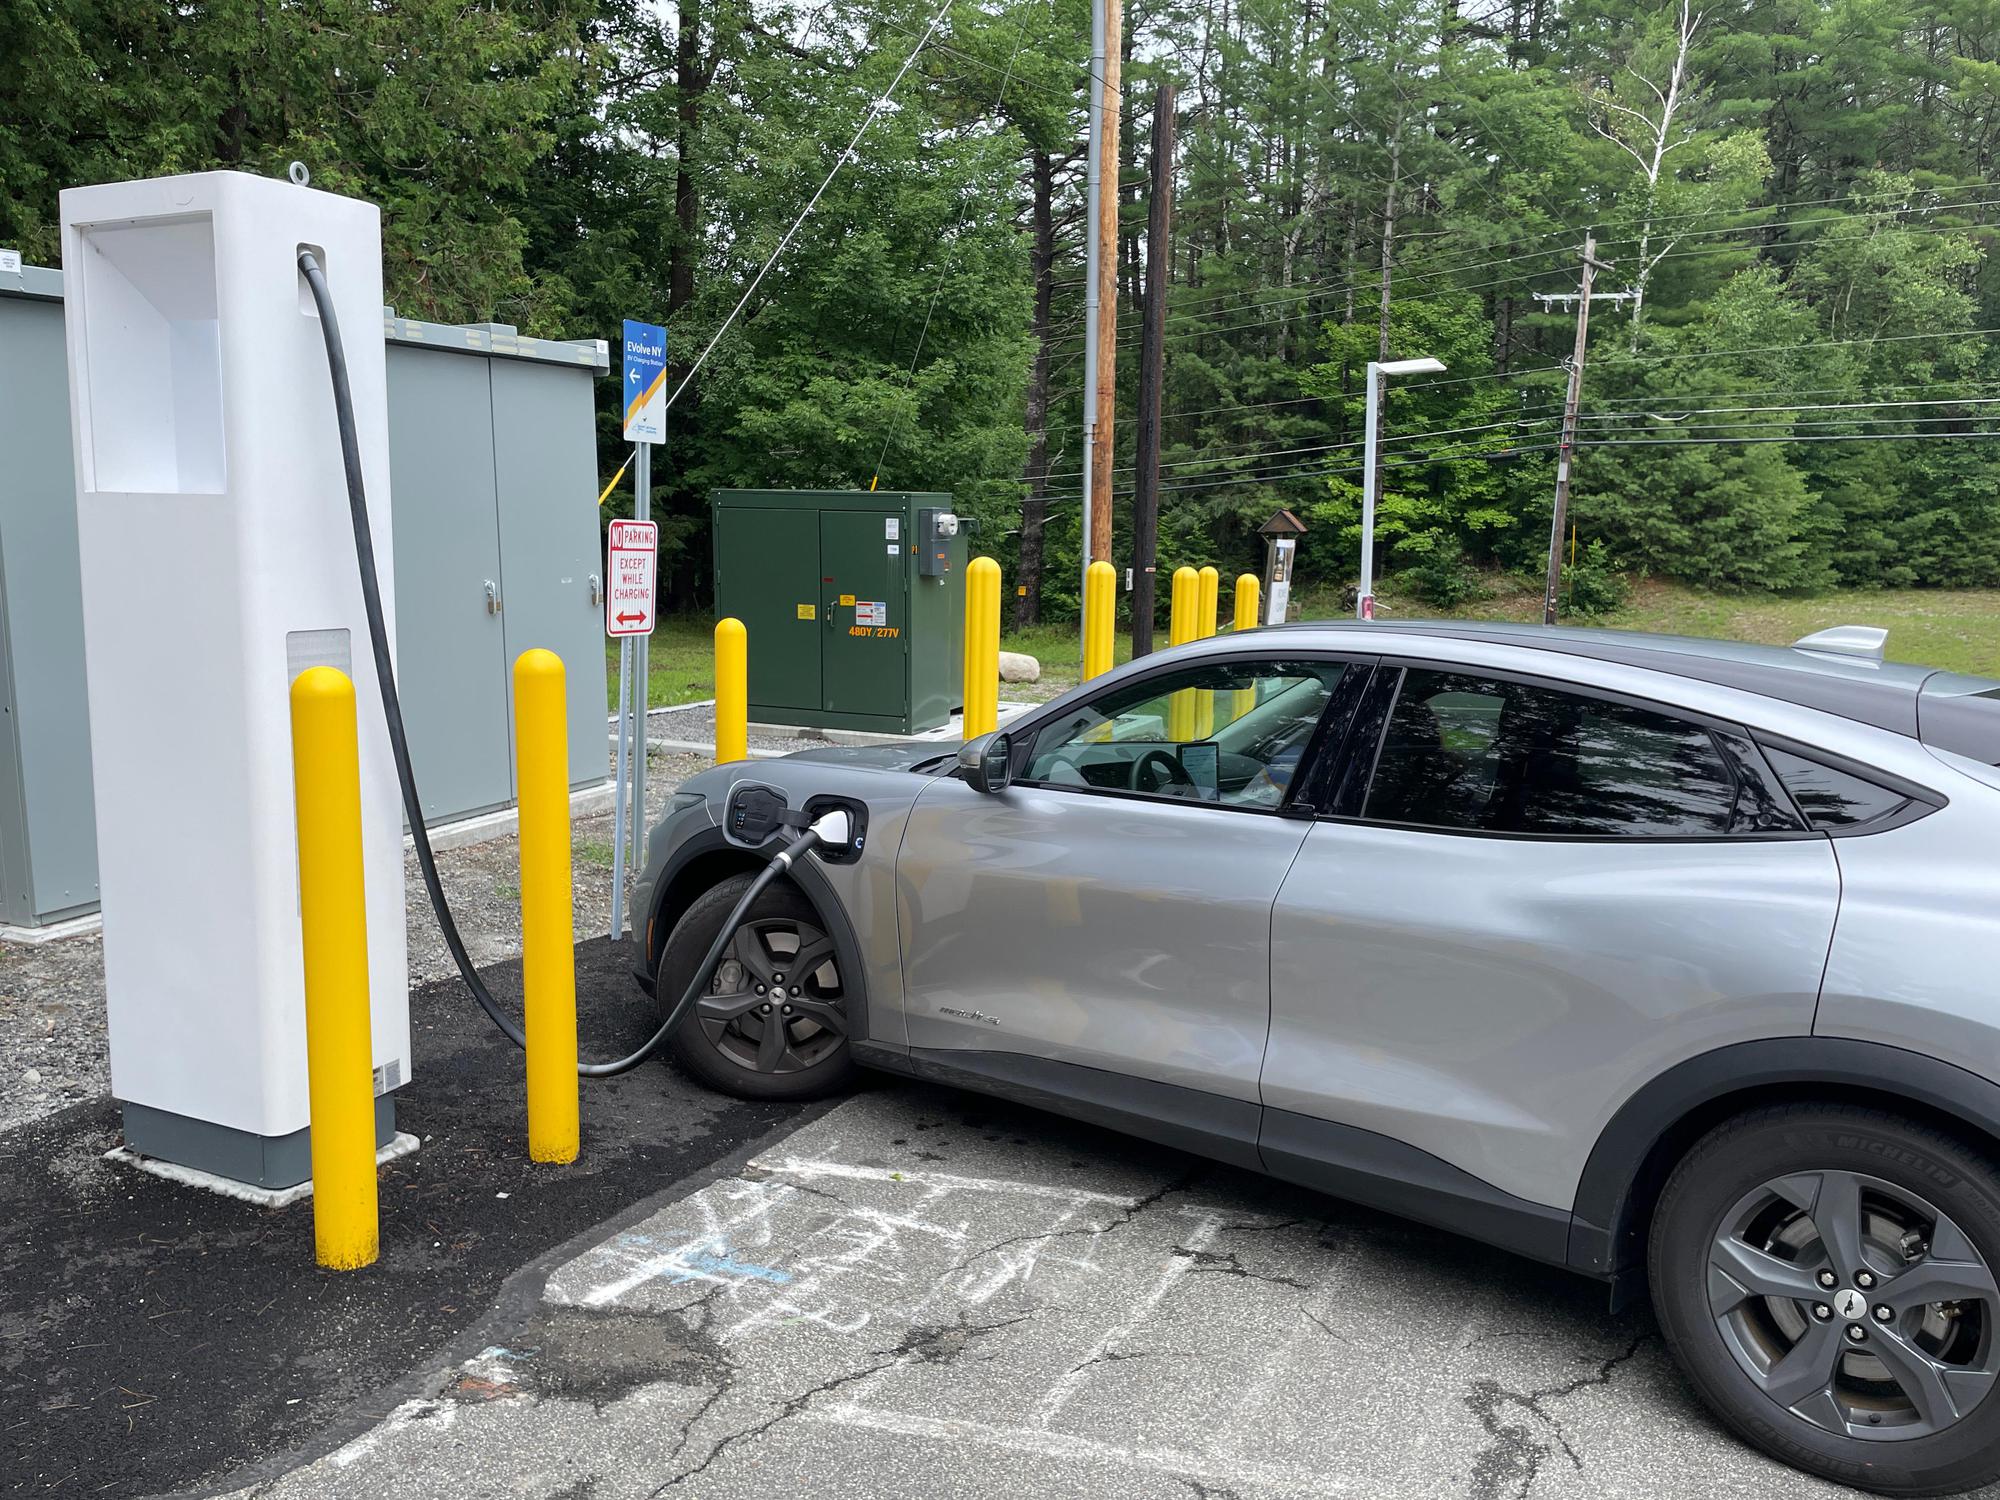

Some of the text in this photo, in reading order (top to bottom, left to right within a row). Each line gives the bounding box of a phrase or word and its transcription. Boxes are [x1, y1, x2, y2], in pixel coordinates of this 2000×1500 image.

[627, 341, 662, 357] EVolve NY
[612, 526, 653, 548] NO PARKING
[620, 558, 646, 570] EXCEPT
[622, 573, 643, 584] WHILE
[614, 588, 649, 600] CHARGING
[849, 626, 899, 638] 480Y/277V
[1837, 1134, 1955, 1185] MICHELIN
